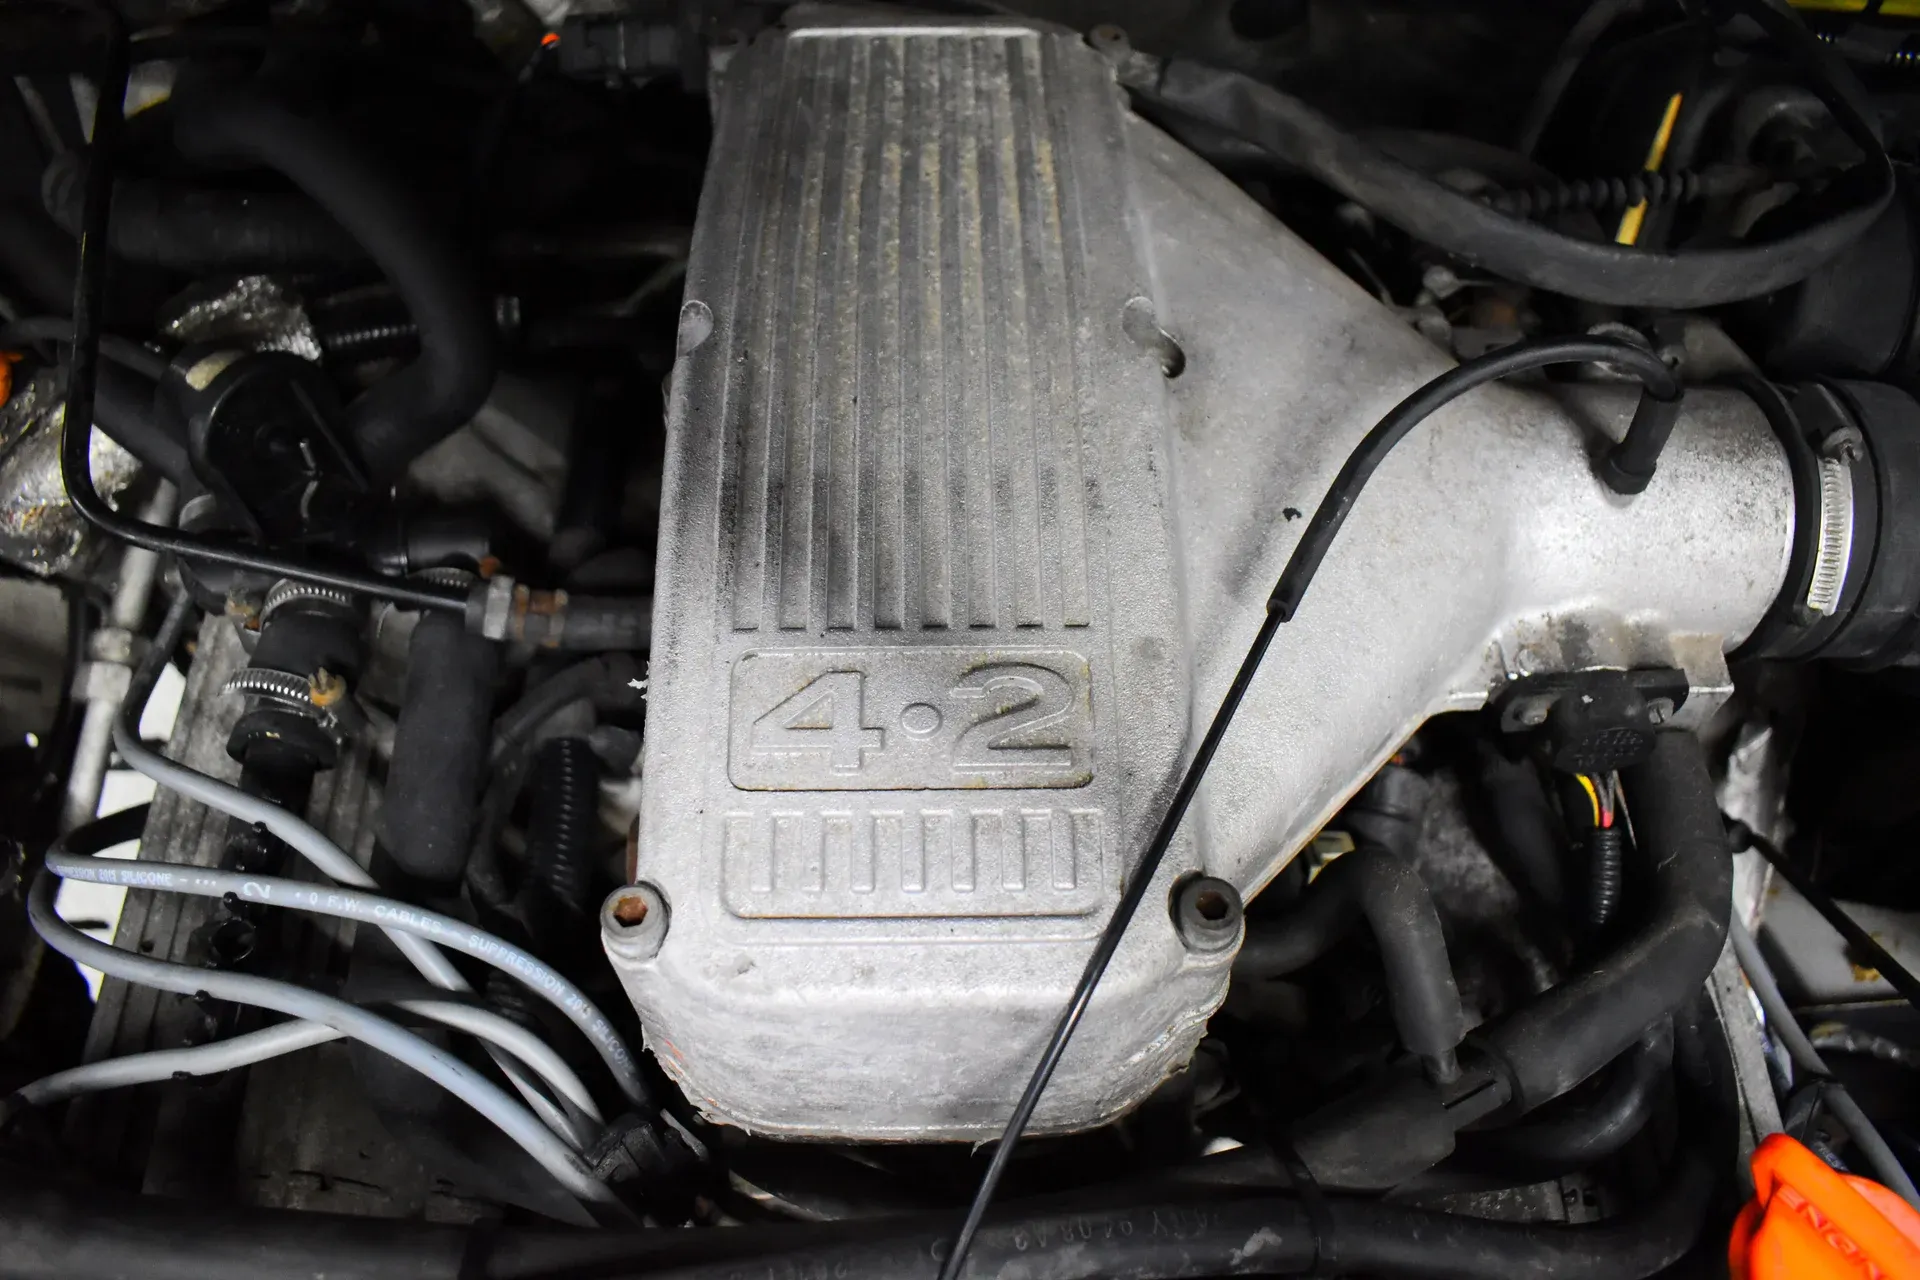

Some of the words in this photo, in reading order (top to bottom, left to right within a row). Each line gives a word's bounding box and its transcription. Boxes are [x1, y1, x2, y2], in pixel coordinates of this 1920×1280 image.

[121, 872, 173, 887] SILICONE
[374, 905, 443, 934] CABLES
[468, 935, 566, 997] SUPPRESSION
